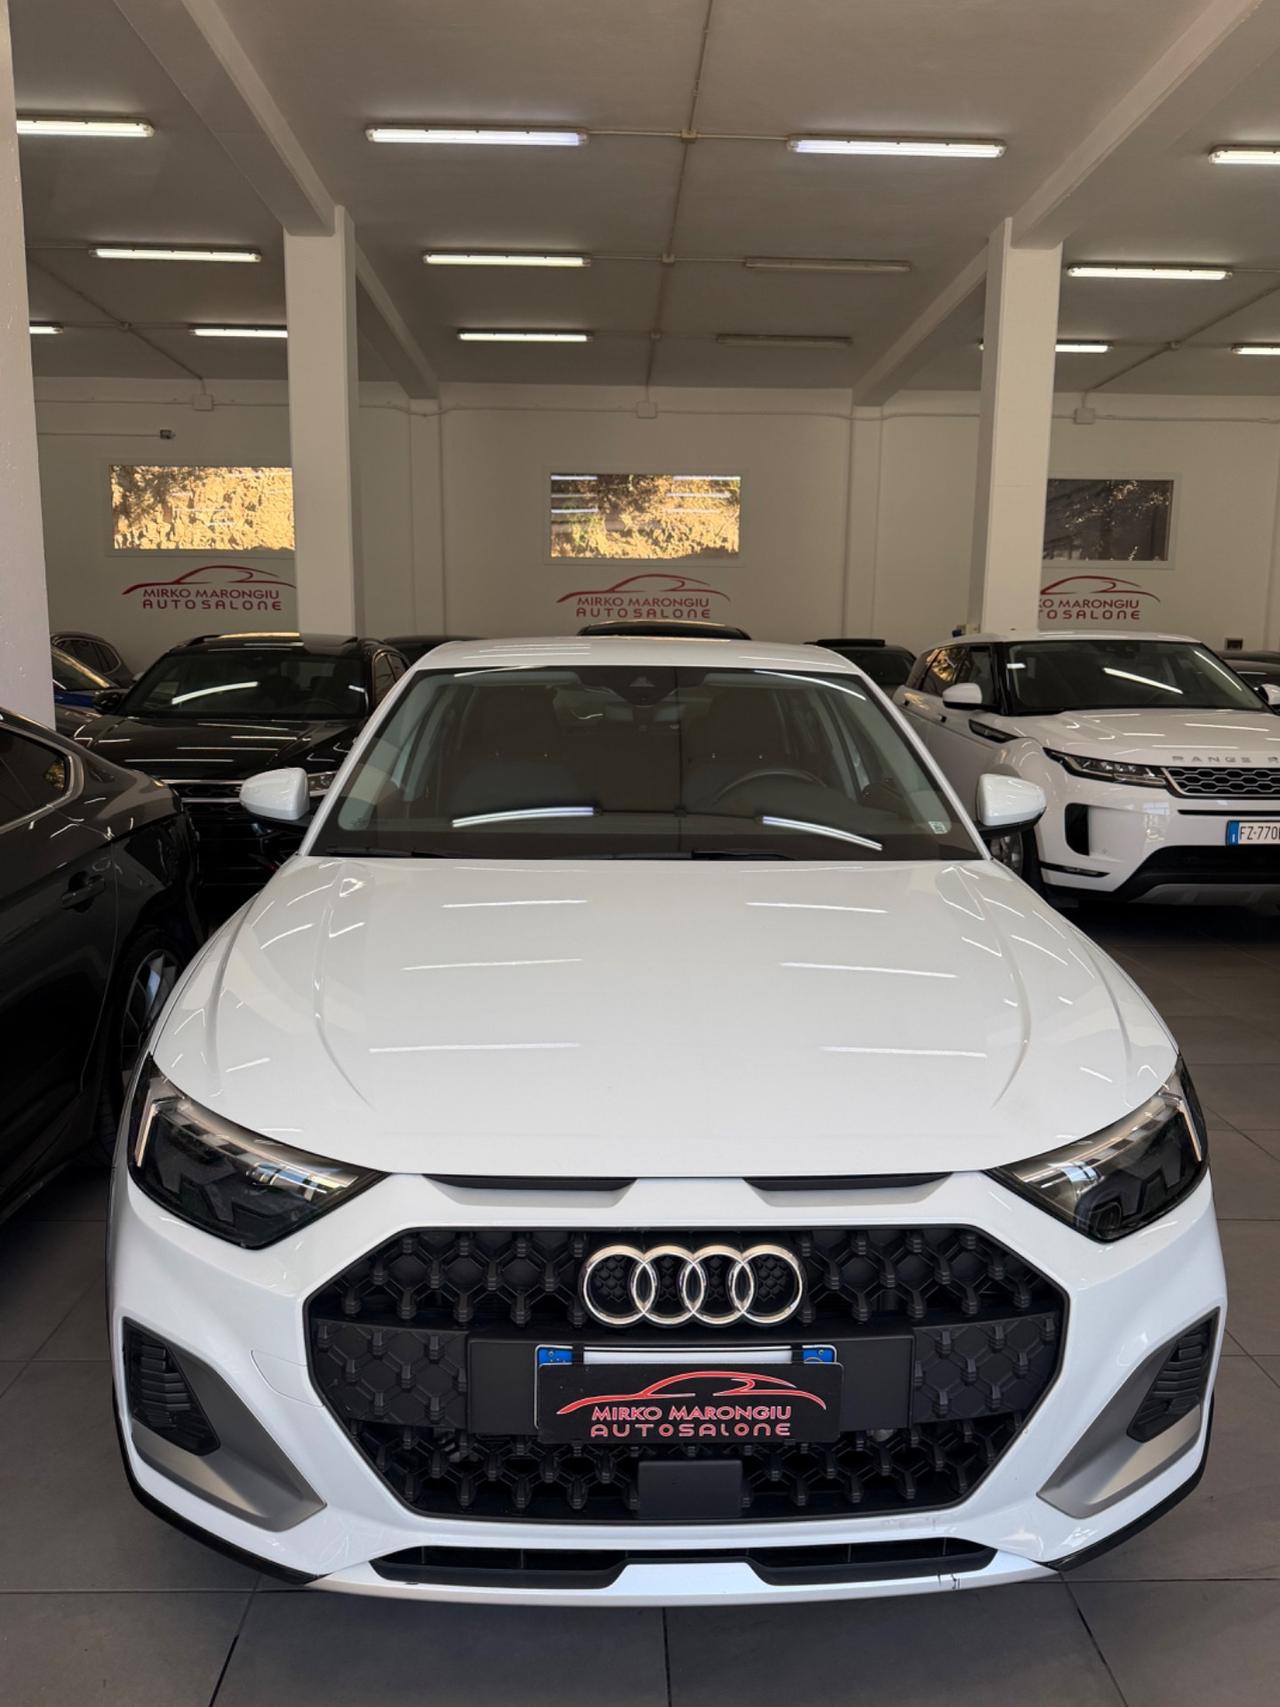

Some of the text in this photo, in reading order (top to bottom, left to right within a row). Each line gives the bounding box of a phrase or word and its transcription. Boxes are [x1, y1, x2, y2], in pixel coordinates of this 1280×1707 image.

[143, 588, 280, 600] MIRKO MARONGIU
[142, 599, 283, 611] AUTOSALONE
[577, 597, 710, 608] MIRKO MARONGIU
[1058, 599, 1140, 609] MARONGIU
[576, 607, 711, 619] AUTOSALONE
[1172, 755, 1252, 764] RANGE
[591, 1405, 792, 1421] MIRKO MARONGIU
[590, 1422, 792, 1438] AUTOSALONE
